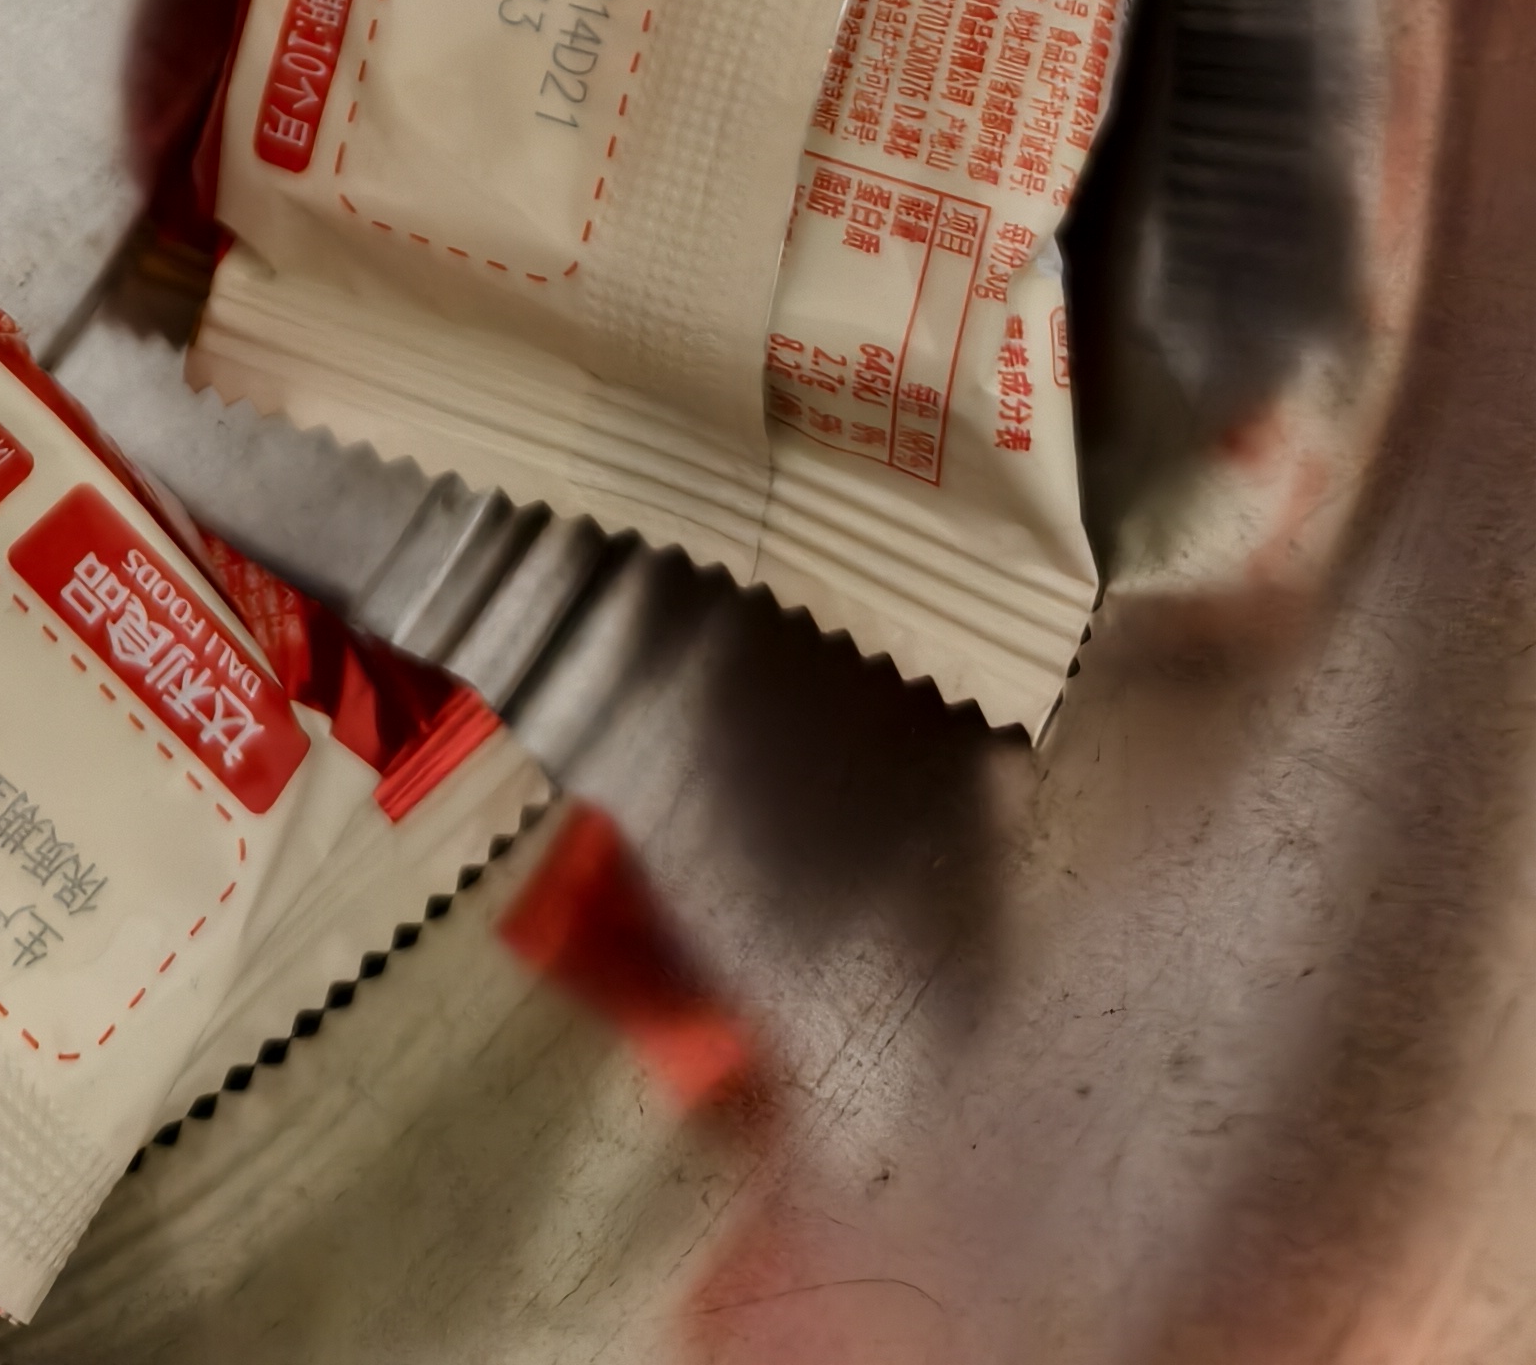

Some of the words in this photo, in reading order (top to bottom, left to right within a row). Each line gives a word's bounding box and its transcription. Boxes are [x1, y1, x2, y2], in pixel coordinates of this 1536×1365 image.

[121, 548, 208, 631] FOODS
[59, 551, 267, 768] 达利食品
[216, 629, 261, 701] DALI
